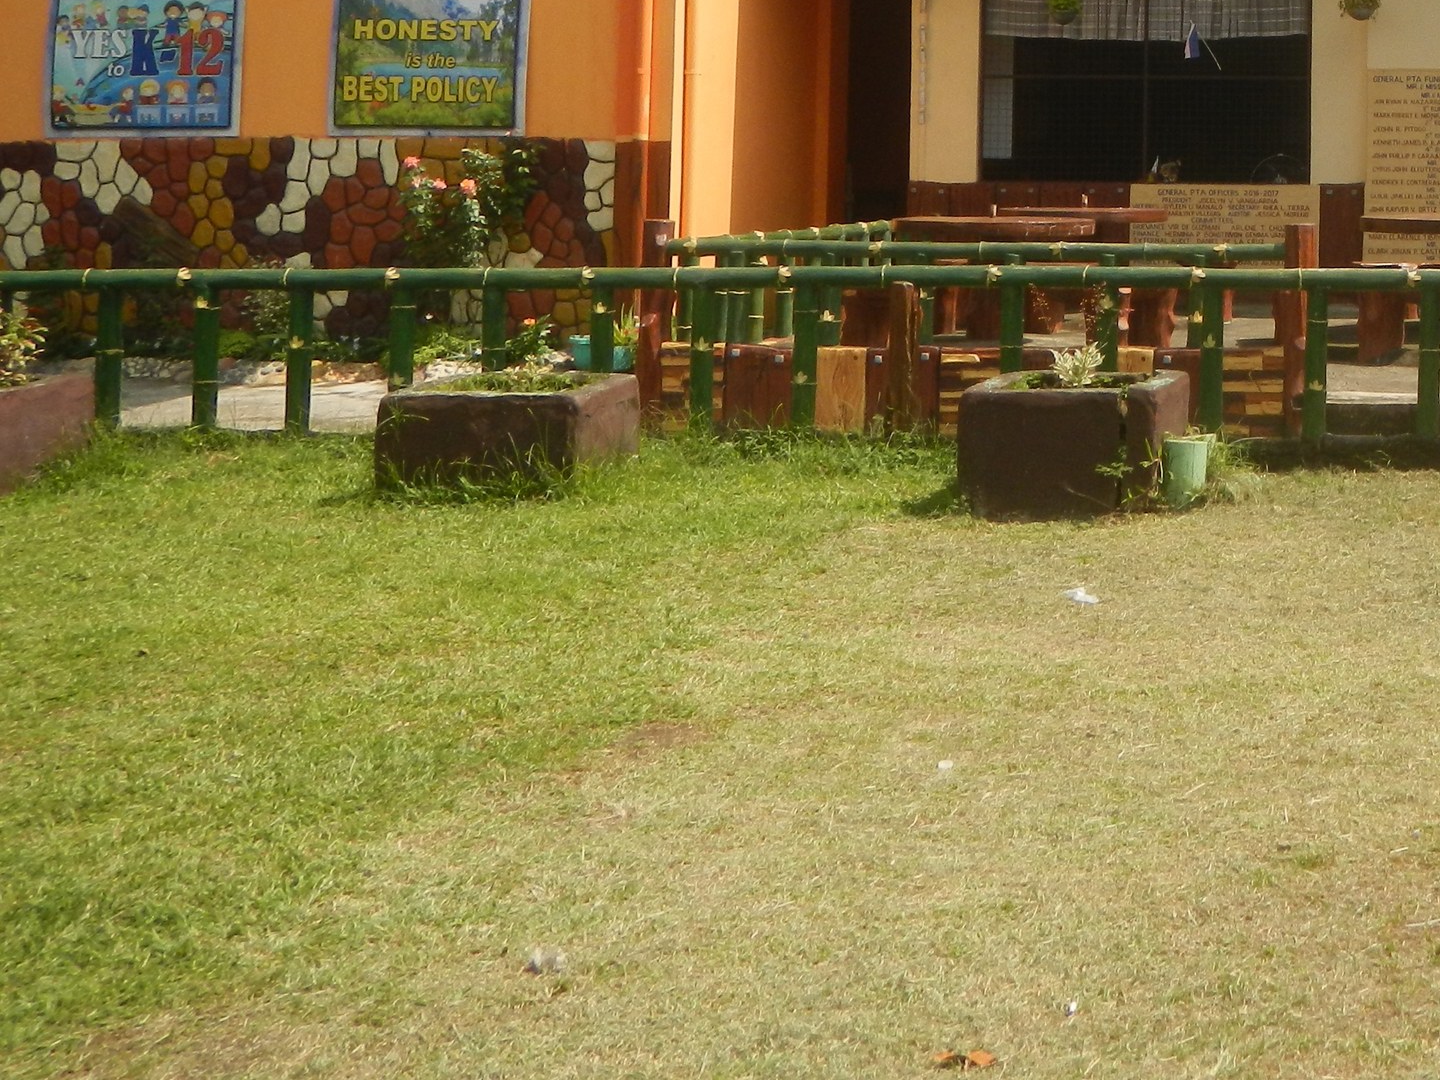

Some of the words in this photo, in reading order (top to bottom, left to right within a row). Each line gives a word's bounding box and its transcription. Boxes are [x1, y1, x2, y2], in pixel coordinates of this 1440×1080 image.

[354, 18, 499, 41] HONESTY
[71, 28, 128, 59] YES
[107, 62, 125, 77] to
[129, 28, 225, 77] K-12
[404, 52, 421, 69] is
[426, 52, 457, 69] the
[343, 75, 404, 103] BEST
[411, 75, 498, 104] POLICY
